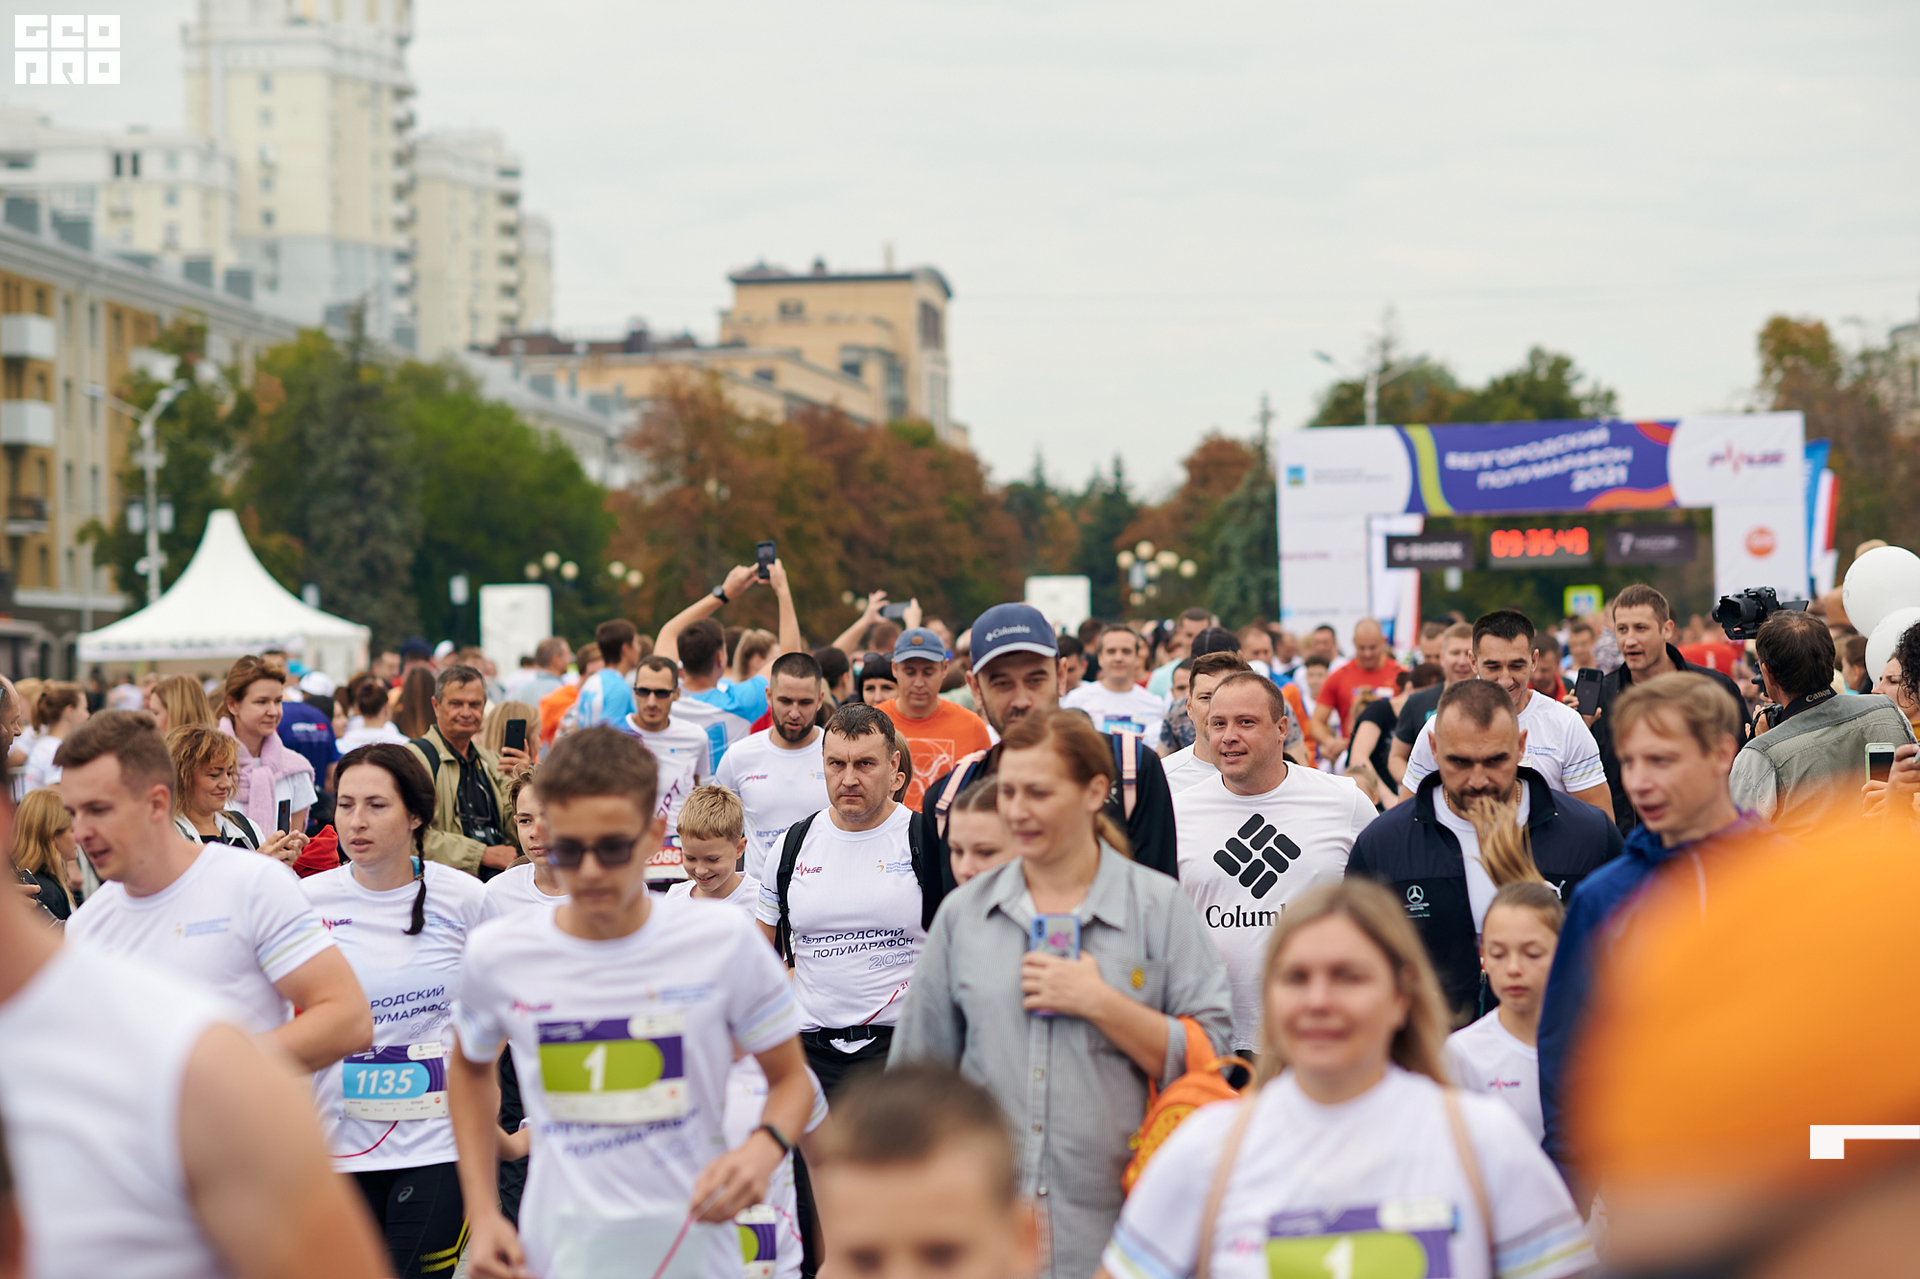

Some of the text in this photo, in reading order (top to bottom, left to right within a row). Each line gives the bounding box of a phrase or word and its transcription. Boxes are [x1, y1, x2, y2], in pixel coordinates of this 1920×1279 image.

[1445, 424, 1610, 470] БЕЛГОРОДСКИЙ
[1477, 446, 1633, 490] ПОЛУМАРАФОН
[1570, 464, 1628, 492] 2021
[993, 624, 1031, 639] Columbia
[1805, 689, 1832, 703] Canon
[813, 937, 915, 959] ПОЛУМАРАФОН
[869, 950, 915, 971] 2021
[356, 1068, 415, 1095] 1135
[582, 1043, 608, 1094] 1
